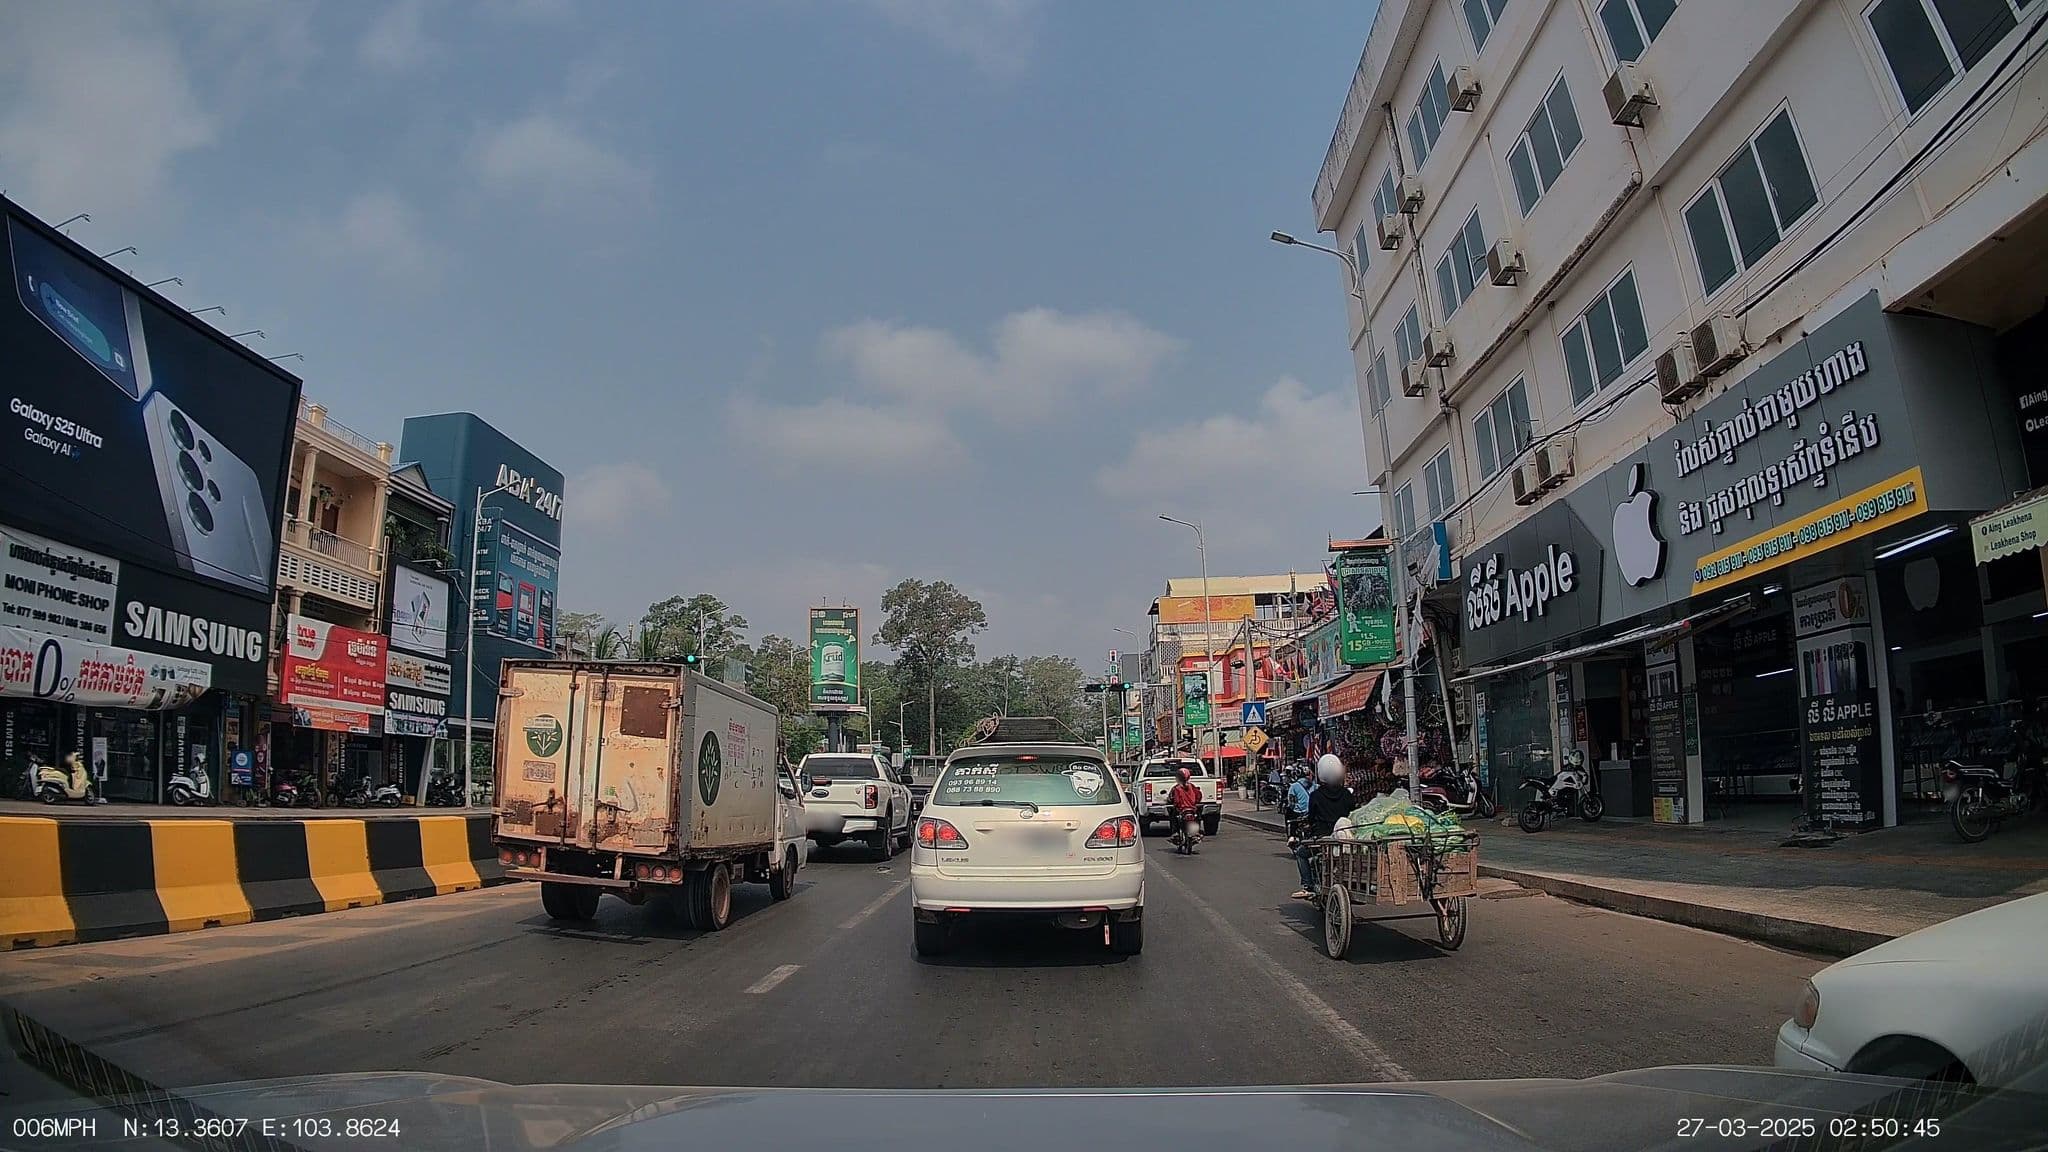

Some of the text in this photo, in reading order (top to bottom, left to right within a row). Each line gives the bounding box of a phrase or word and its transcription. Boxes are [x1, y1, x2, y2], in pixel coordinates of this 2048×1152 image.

[10, 398, 103, 449] Galaxy S25 Ultra
[24, 428, 71, 456] Galaxy AI
[535, 486, 563, 521] 24/7
[1702, 562, 1717, 580] 092
[1718, 558, 1731, 576] 815
[1731, 554, 1743, 570] 911
[1748, 545, 1763, 563] 093
[1764, 542, 1778, 559] 815
[1779, 535, 1793, 551] 911
[1799, 525, 1816, 545] 098
[1817, 519, 1834, 538] 815
[1835, 511, 1850, 530] 911
[1856, 503, 1876, 523] 099
[1877, 494, 1895, 513] 815
[1896, 482, 1915, 505] 911
[1988, 512, 2033, 535] Aing Leakhena
[1990, 529, 2037, 552] Leakhena Shop
[5, 574, 110, 612] MONI PHONE SHOP
[1506, 544, 1573, 622] Apple
[125, 600, 263, 663] SAMSUNG
[297, 624, 316, 639] true
[1348, 640, 1362, 651] 15
[389, 692, 446, 716] SAMSUNG
[1837, 702, 1873, 720] APPLE
